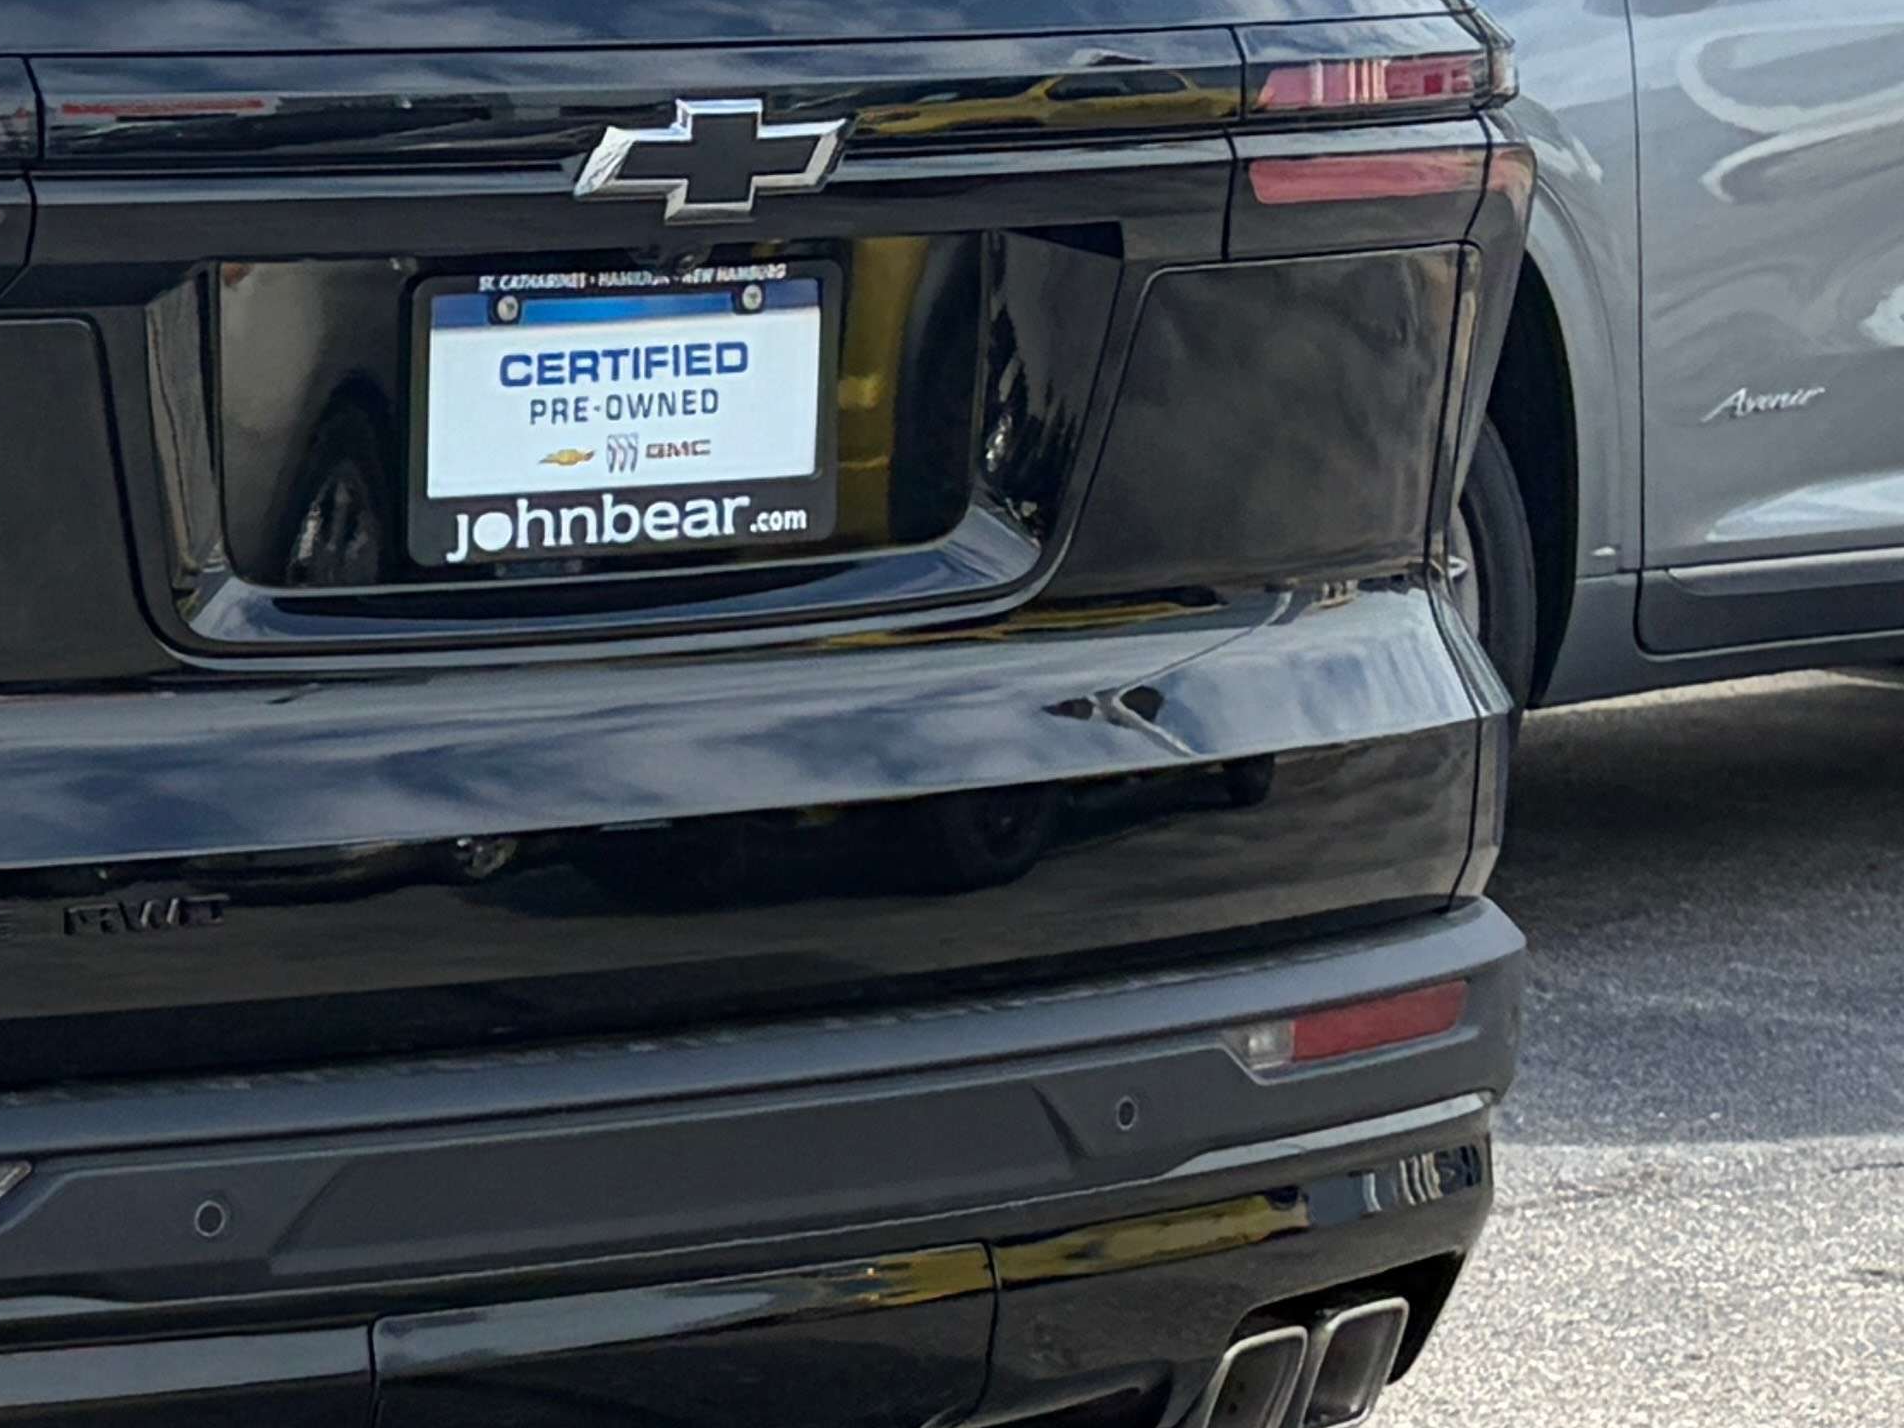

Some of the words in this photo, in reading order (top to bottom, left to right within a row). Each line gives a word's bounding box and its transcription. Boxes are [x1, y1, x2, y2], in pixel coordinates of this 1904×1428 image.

[499, 341, 750, 388] CERTIFIED
[529, 388, 720, 426] PRE-OWNED
[645, 438, 711, 460] GMC
